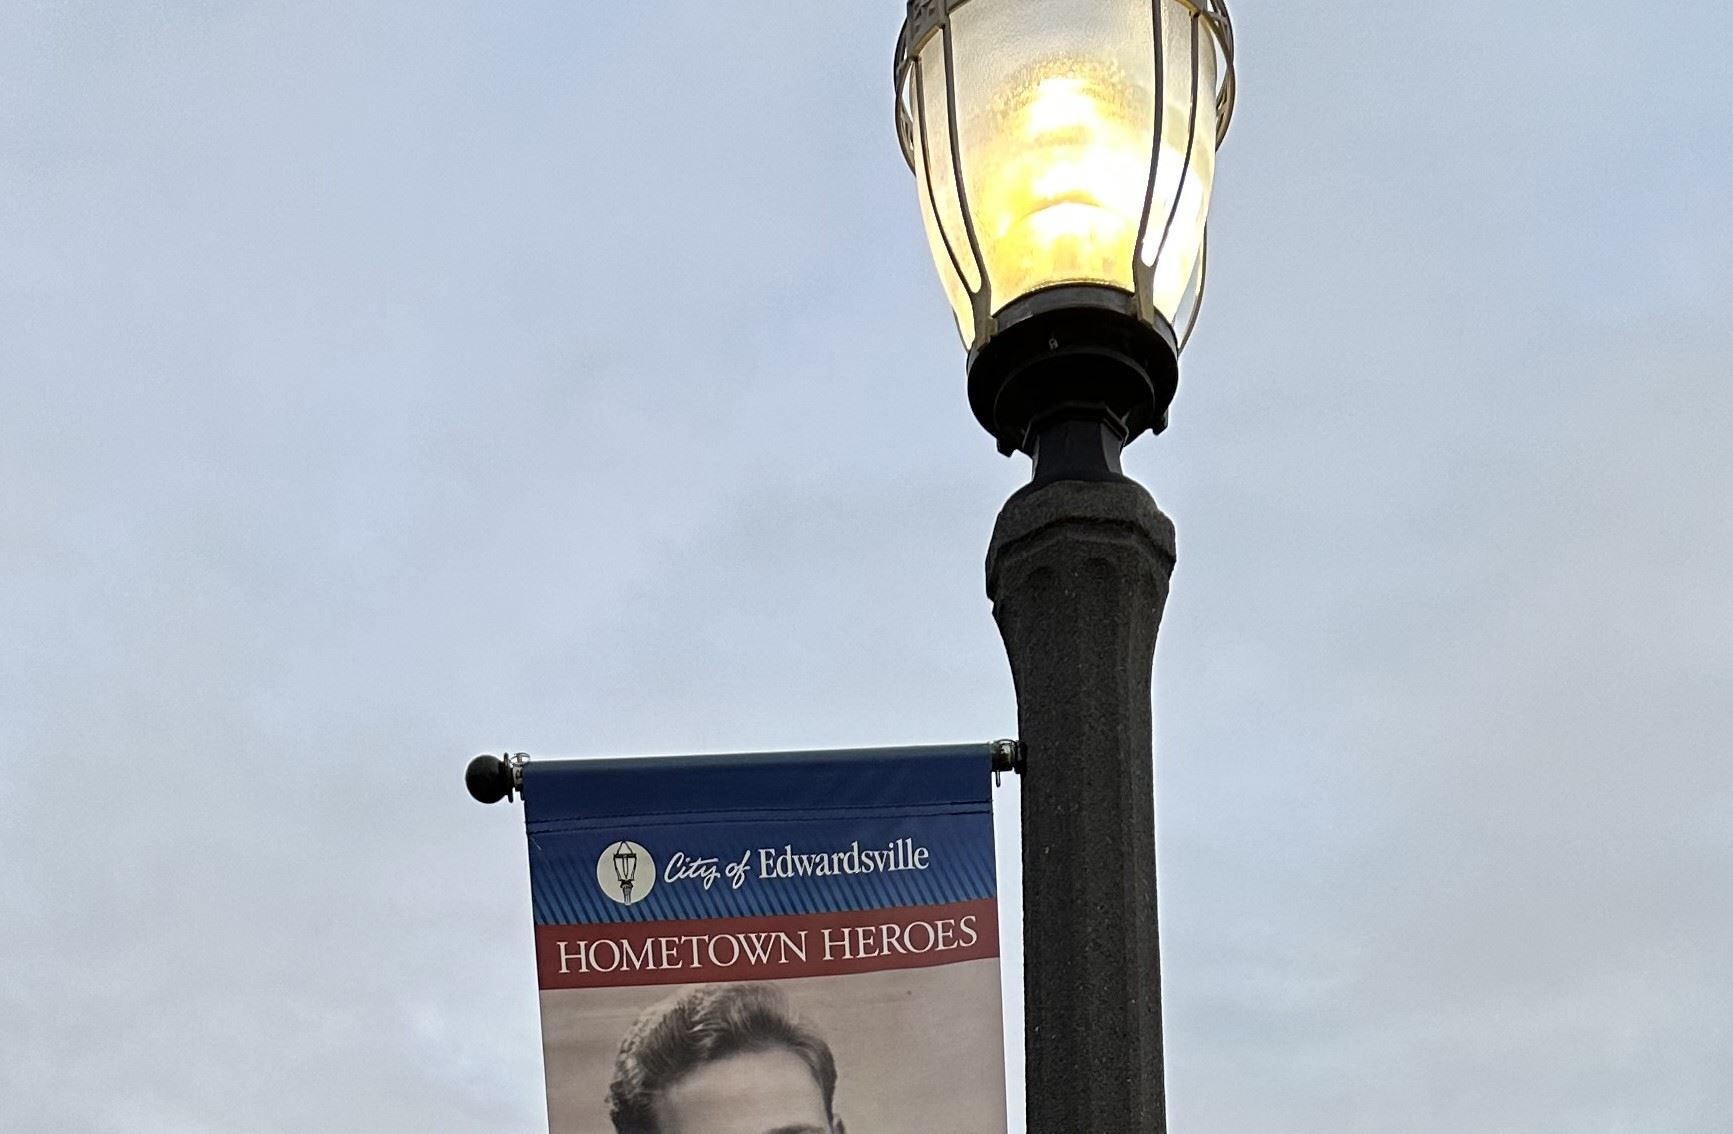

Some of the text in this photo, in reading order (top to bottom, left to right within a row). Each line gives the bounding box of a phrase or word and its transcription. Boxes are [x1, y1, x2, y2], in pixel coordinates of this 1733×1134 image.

[664, 837, 929, 890] City of Edwardsville
[556, 914, 978, 974] HOMETOWN HEROES
